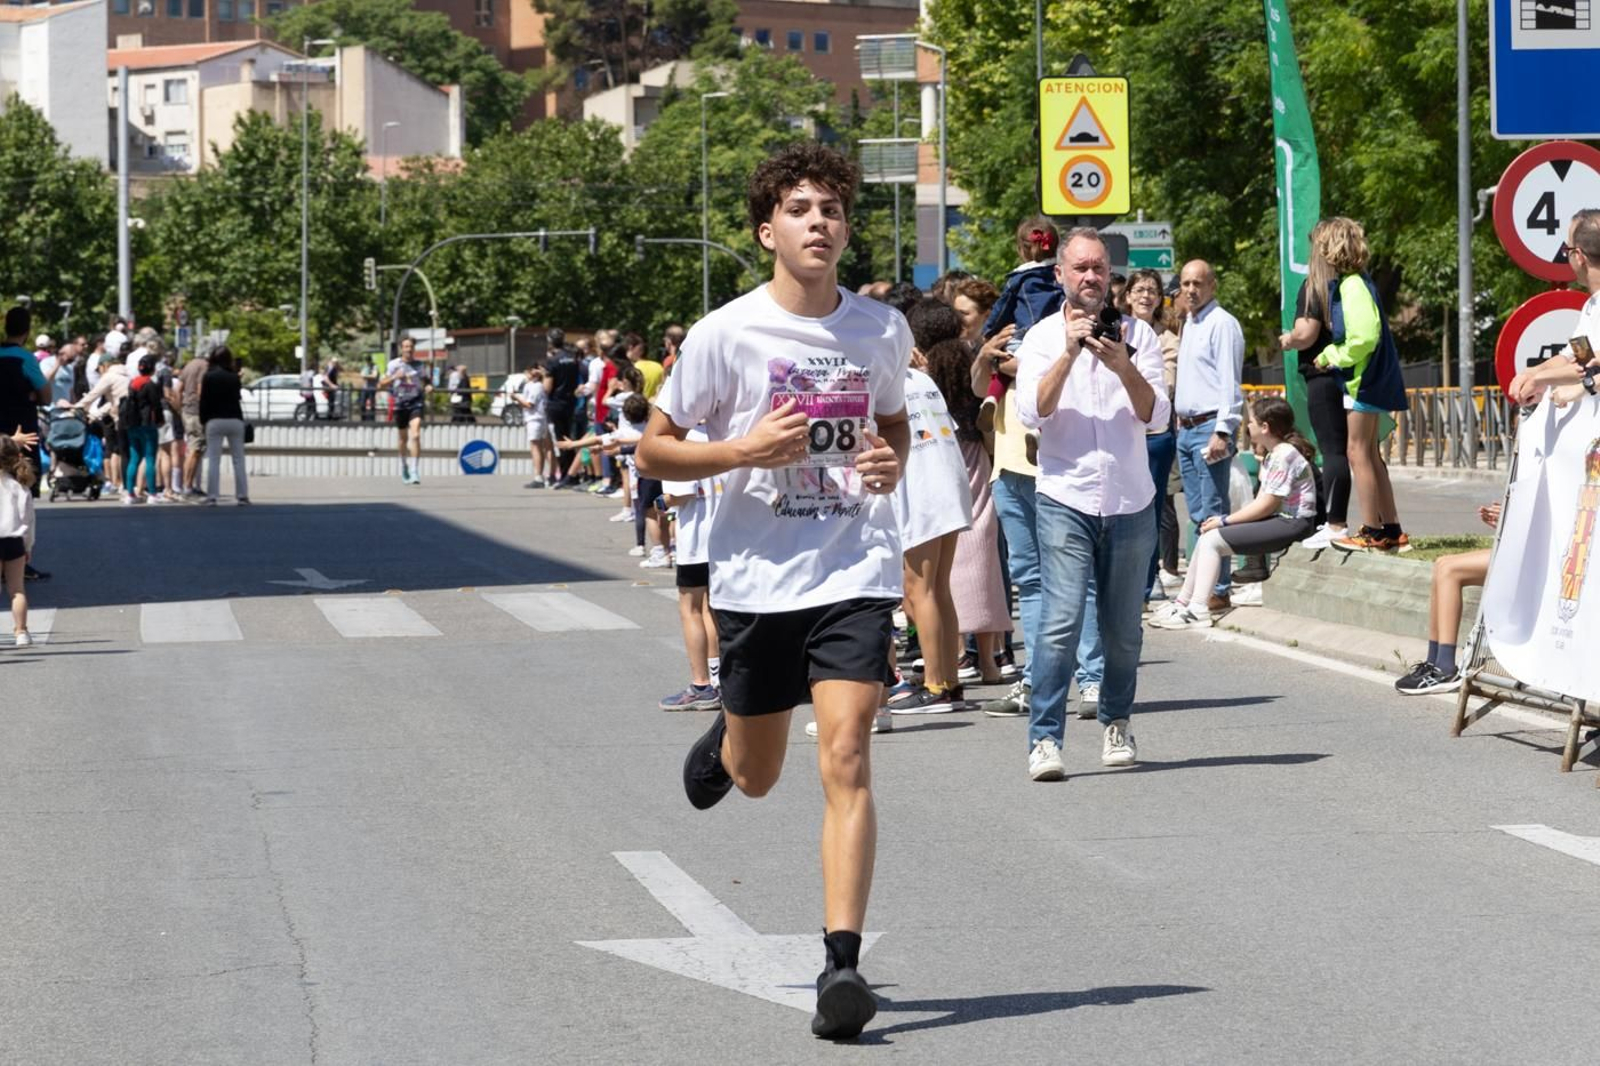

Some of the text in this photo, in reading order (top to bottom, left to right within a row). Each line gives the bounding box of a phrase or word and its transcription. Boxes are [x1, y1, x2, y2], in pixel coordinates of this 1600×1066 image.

[1045, 82, 1124, 93] ATENCION
[1071, 172, 1101, 188] 20
[1526, 191, 1560, 235] 4
